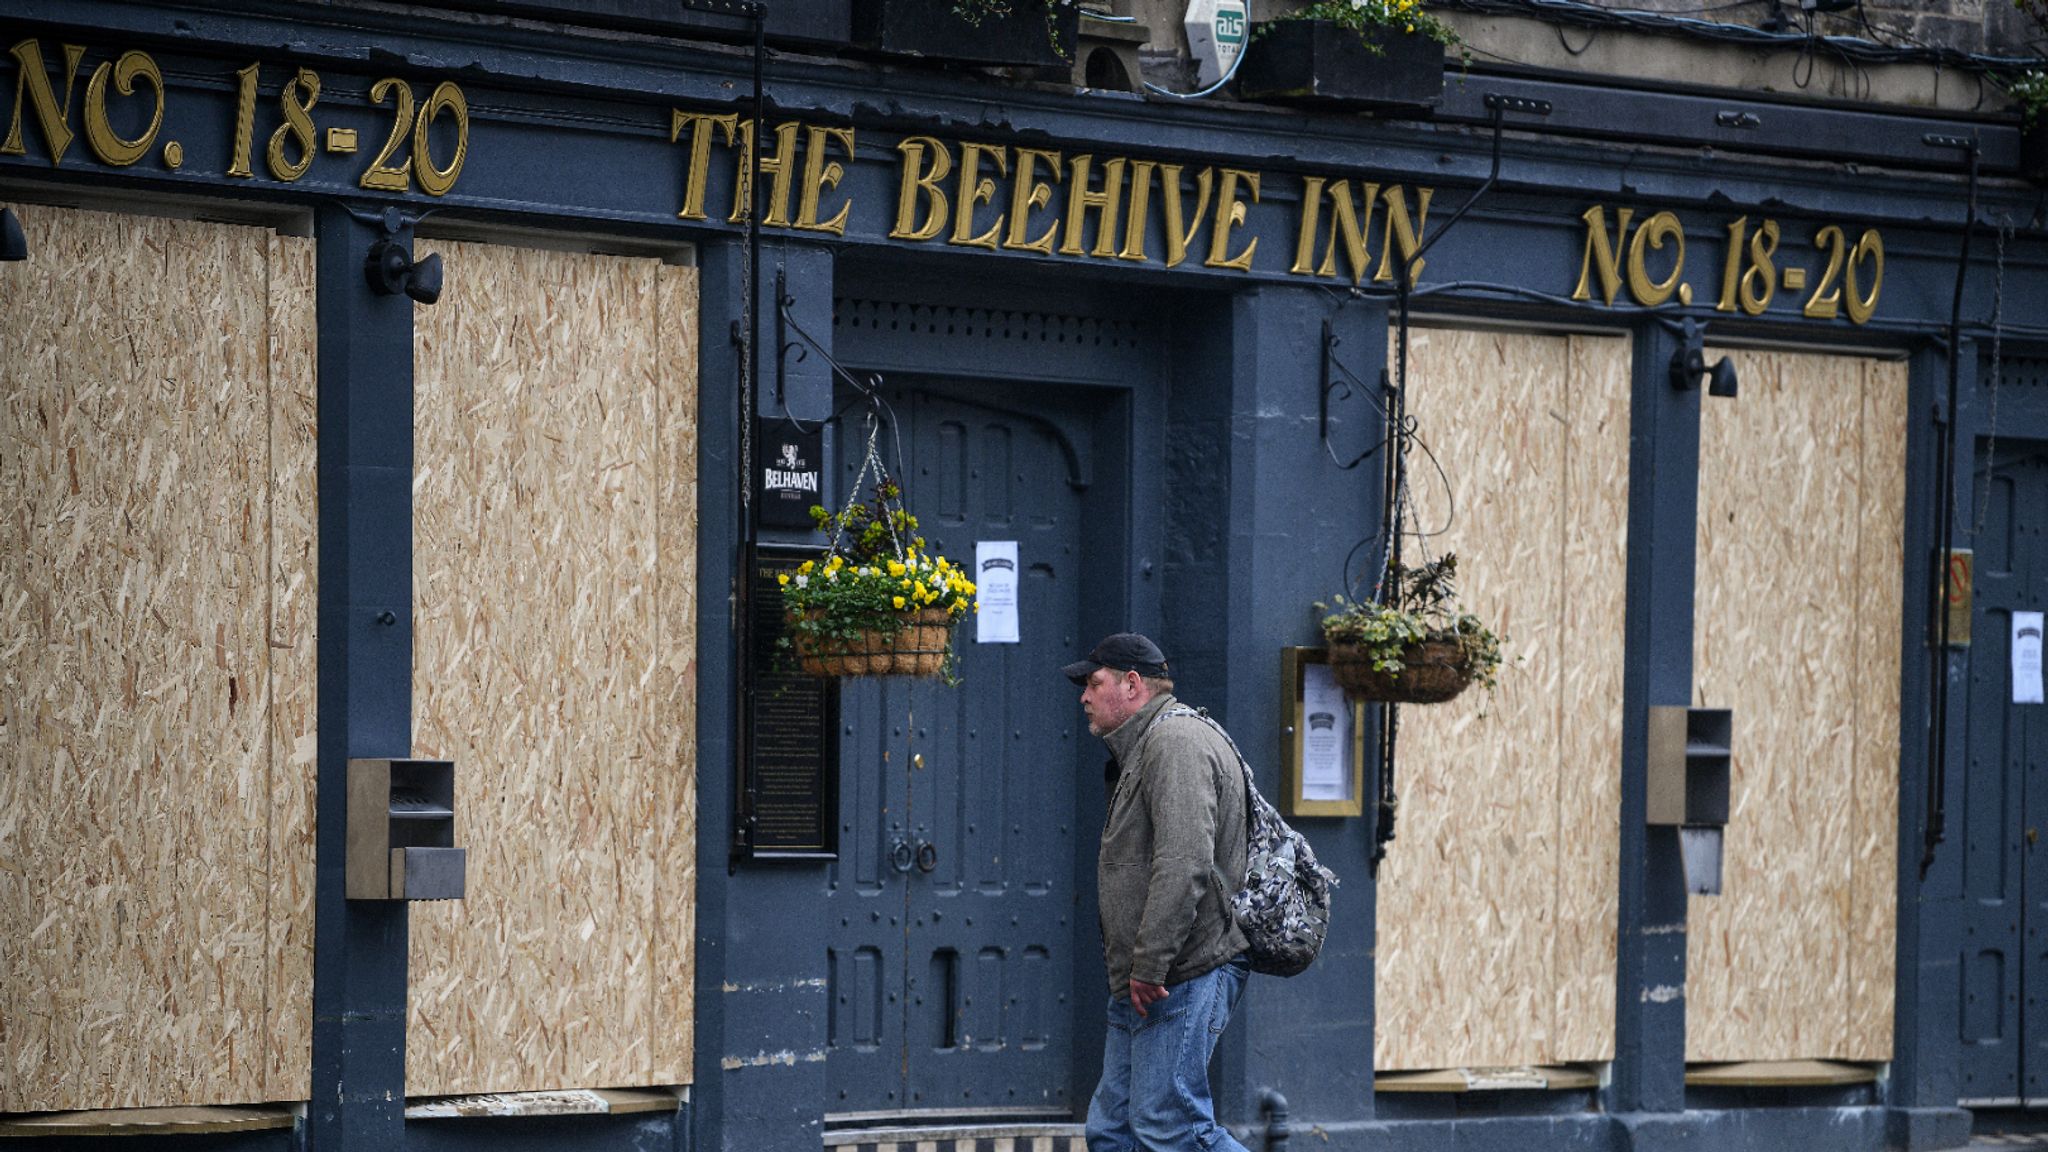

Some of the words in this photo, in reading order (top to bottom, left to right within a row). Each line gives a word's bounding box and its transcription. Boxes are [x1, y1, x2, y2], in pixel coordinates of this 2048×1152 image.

[1, 38, 184, 168] NO.
[227, 62, 469, 196] 18-20
[672, 108, 855, 236] THE
[889, 136, 1261, 272] BEEHIVE
[1290, 176, 1435, 289] INN
[1573, 205, 1693, 307] NO.
[1716, 215, 1885, 325] 18-20
[765, 468, 818, 492] BELHAVEN
